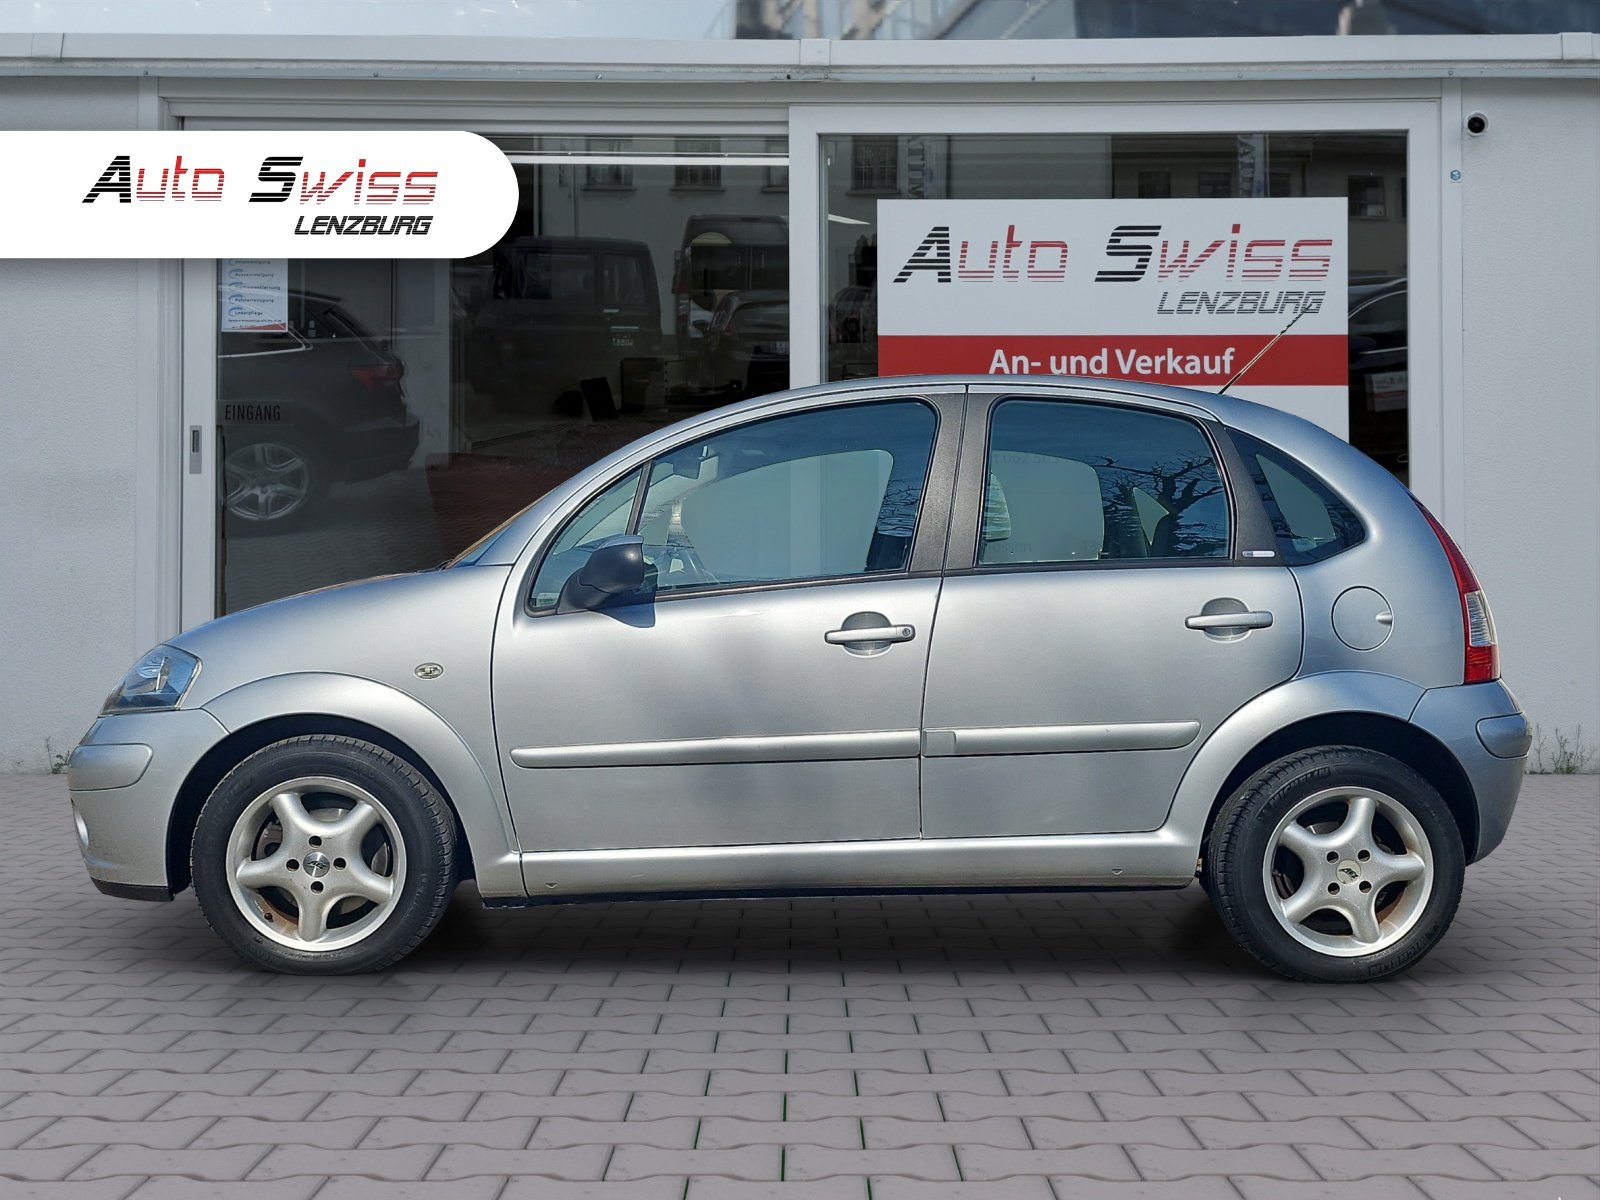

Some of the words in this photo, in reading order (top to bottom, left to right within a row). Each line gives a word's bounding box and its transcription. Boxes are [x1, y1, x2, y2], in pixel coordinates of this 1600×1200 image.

[893, 225, 1068, 283] Auto
[1095, 224, 1333, 282] Swiss
[1157, 290, 1327, 314] LENZBURG
[988, 348, 1042, 375] An-
[1050, 347, 1109, 375] und
[1115, 347, 1236, 375] Verkauf
[225, 404, 281, 421] EINGANG
